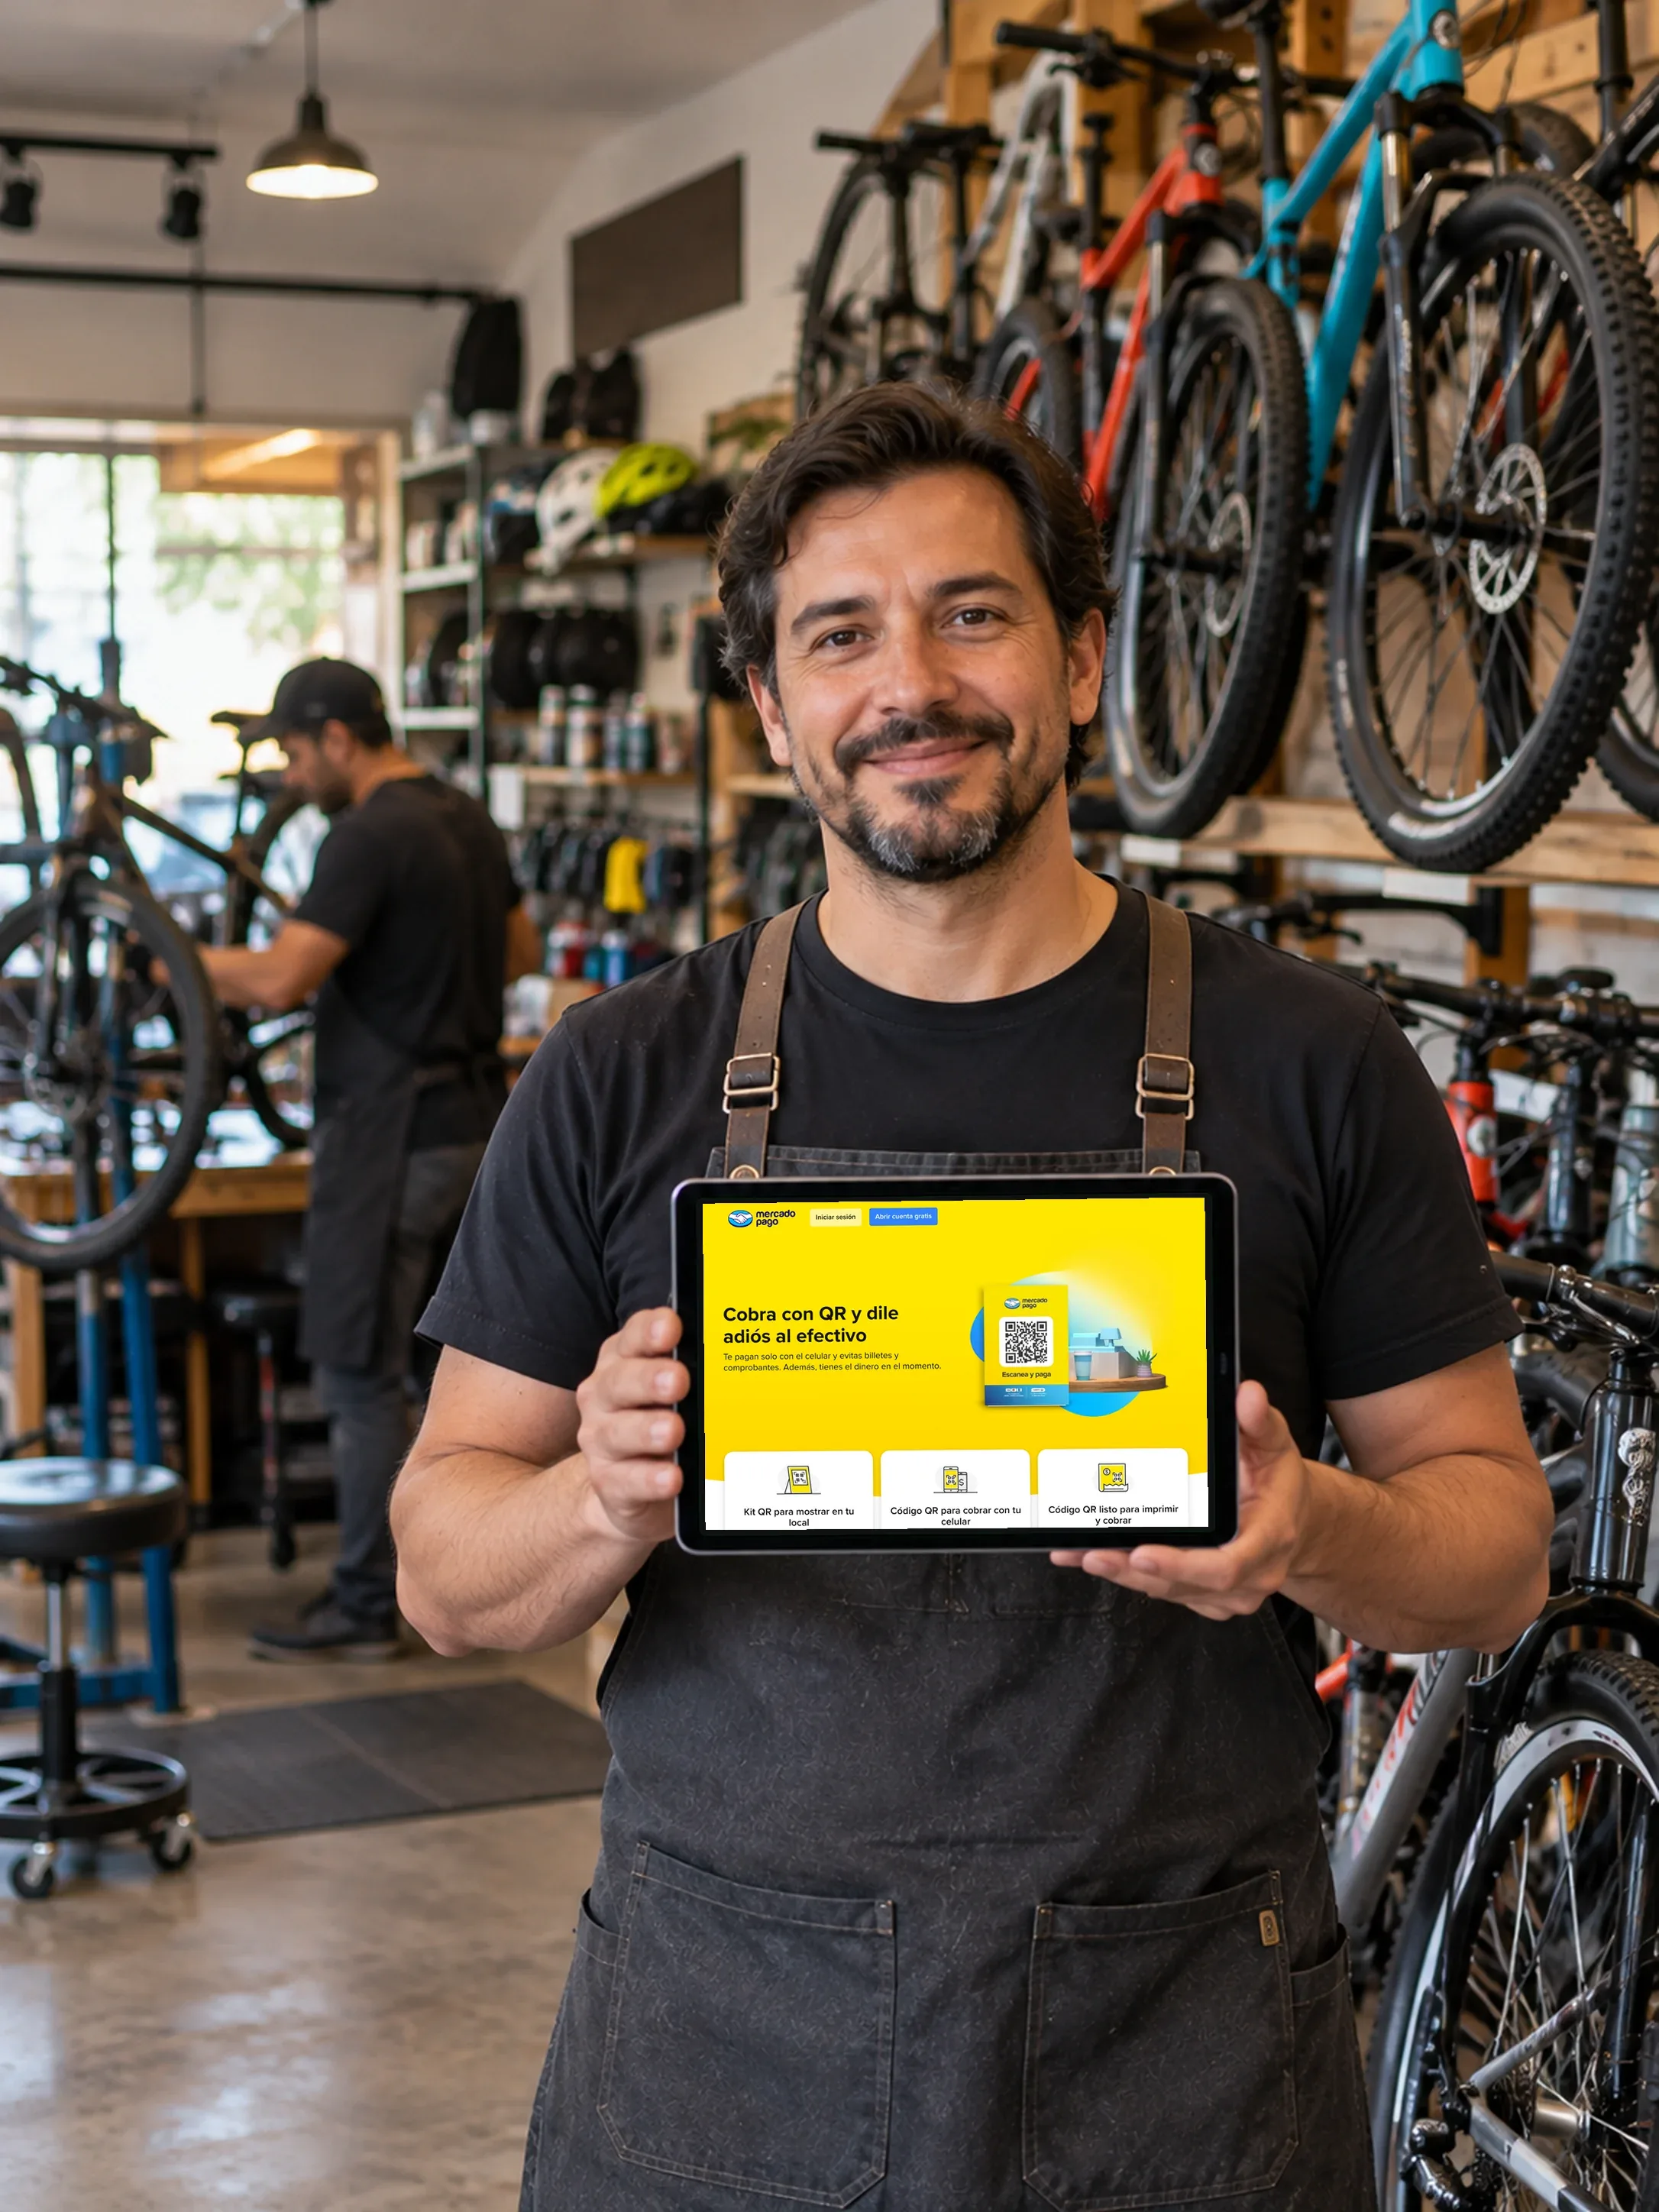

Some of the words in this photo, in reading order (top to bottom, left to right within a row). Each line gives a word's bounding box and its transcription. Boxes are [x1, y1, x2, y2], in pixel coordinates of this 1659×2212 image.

[755, 1209, 796, 1219] mercado
[914, 1212, 933, 1221] gratis
[755, 1218, 779, 1227] pago
[723, 1307, 777, 1322] Cobra
[781, 1309, 813, 1321] con
[819, 1306, 846, 1321] QR
[851, 1309, 862, 1324] y
[866, 1305, 899, 1321] dile
[723, 1328, 771, 1344] adiós
[775, 1328, 791, 1344] al
[796, 1328, 867, 1343] efectivo
[723, 1363, 781, 1372] comprobantes.
[783, 1363, 817, 1372] Además,
[744, 1508, 756, 1516] Kit
[758, 1508, 772, 1516] QR
[774, 1509, 794, 1518] para
[890, 1506, 923, 1516] Código
[924, 1506, 939, 1515] QR
[940, 1508, 961, 1516] para
[962, 1506, 992, 1515] cobrar
[1012, 1506, 1022, 1515] tu
[1048, 1505, 1081, 1515] Código
[1082, 1505, 1097, 1514] QR
[1099, 1505, 1117, 1514] listo
[1120, 1506, 1140, 1515] para
[1142, 1505, 1179, 1515] imprimir
[788, 1518, 810, 1527] local
[941, 1517, 971, 1526] celular
[1095, 1517, 1101, 1526] y
[1102, 1515, 1132, 1525] cobrar
